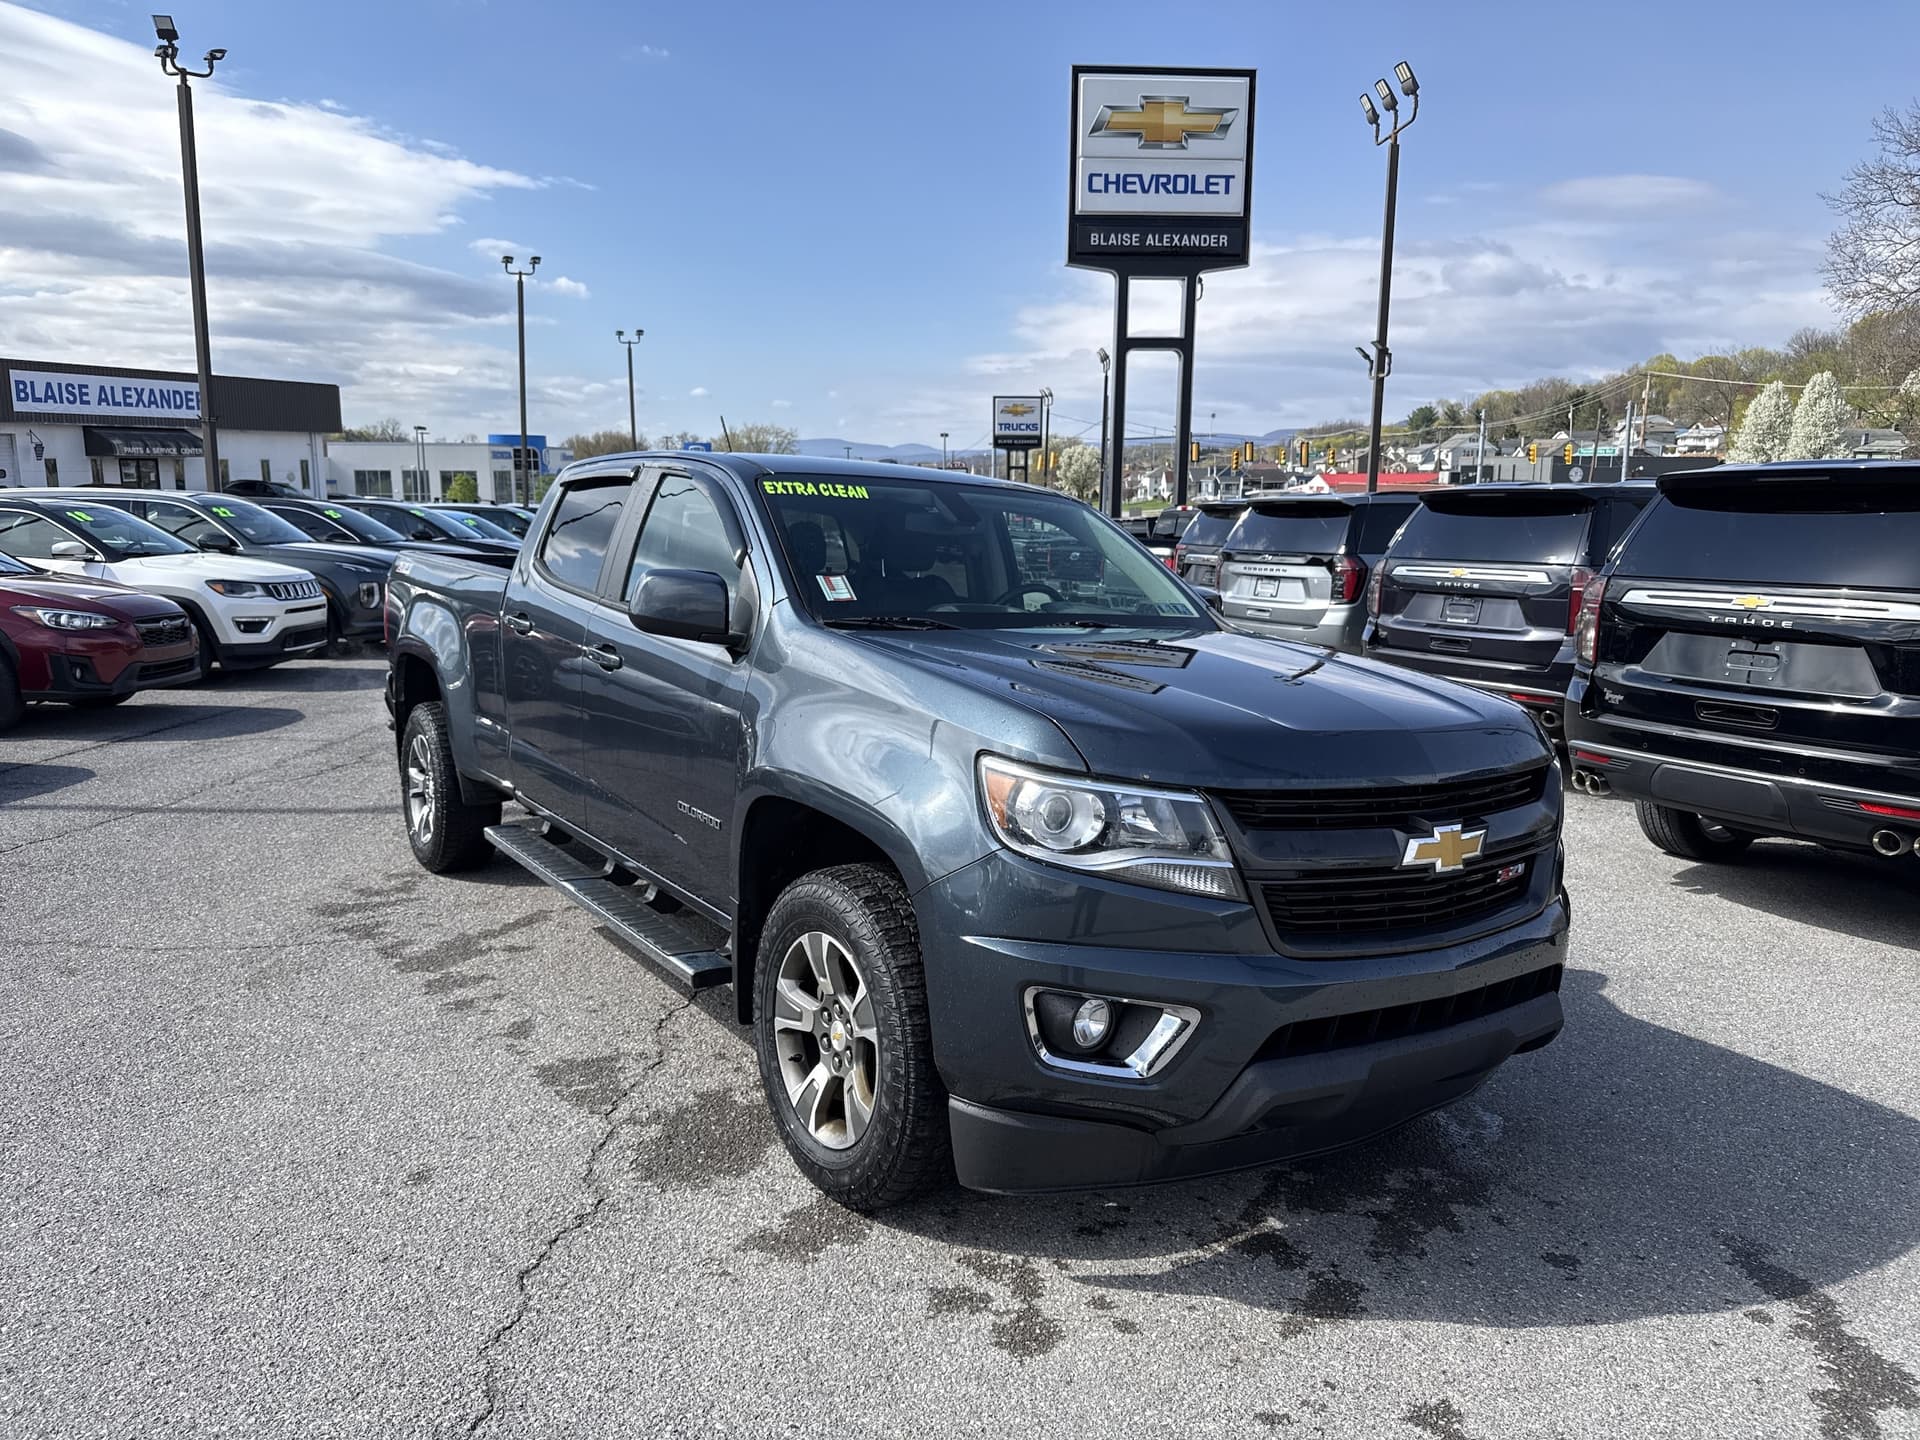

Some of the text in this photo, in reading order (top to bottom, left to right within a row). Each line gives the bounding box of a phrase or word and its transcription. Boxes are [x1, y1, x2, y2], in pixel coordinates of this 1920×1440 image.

[1087, 173, 1235, 195] CHEVROLET
[1090, 233, 1228, 247] BLAISE ALEXANDER
[14, 379, 91, 406] BLAISE
[998, 423, 1039, 431] TRUCKS
[123, 446, 144, 454] PARTS
[152, 447, 178, 455] SERVICE
[763, 481, 869, 499] EXTRA CLEAN
[1436, 581, 1480, 589] TAHOE
[1708, 615, 1793, 629] TAHOE
[677, 800, 721, 830] COLORADO
